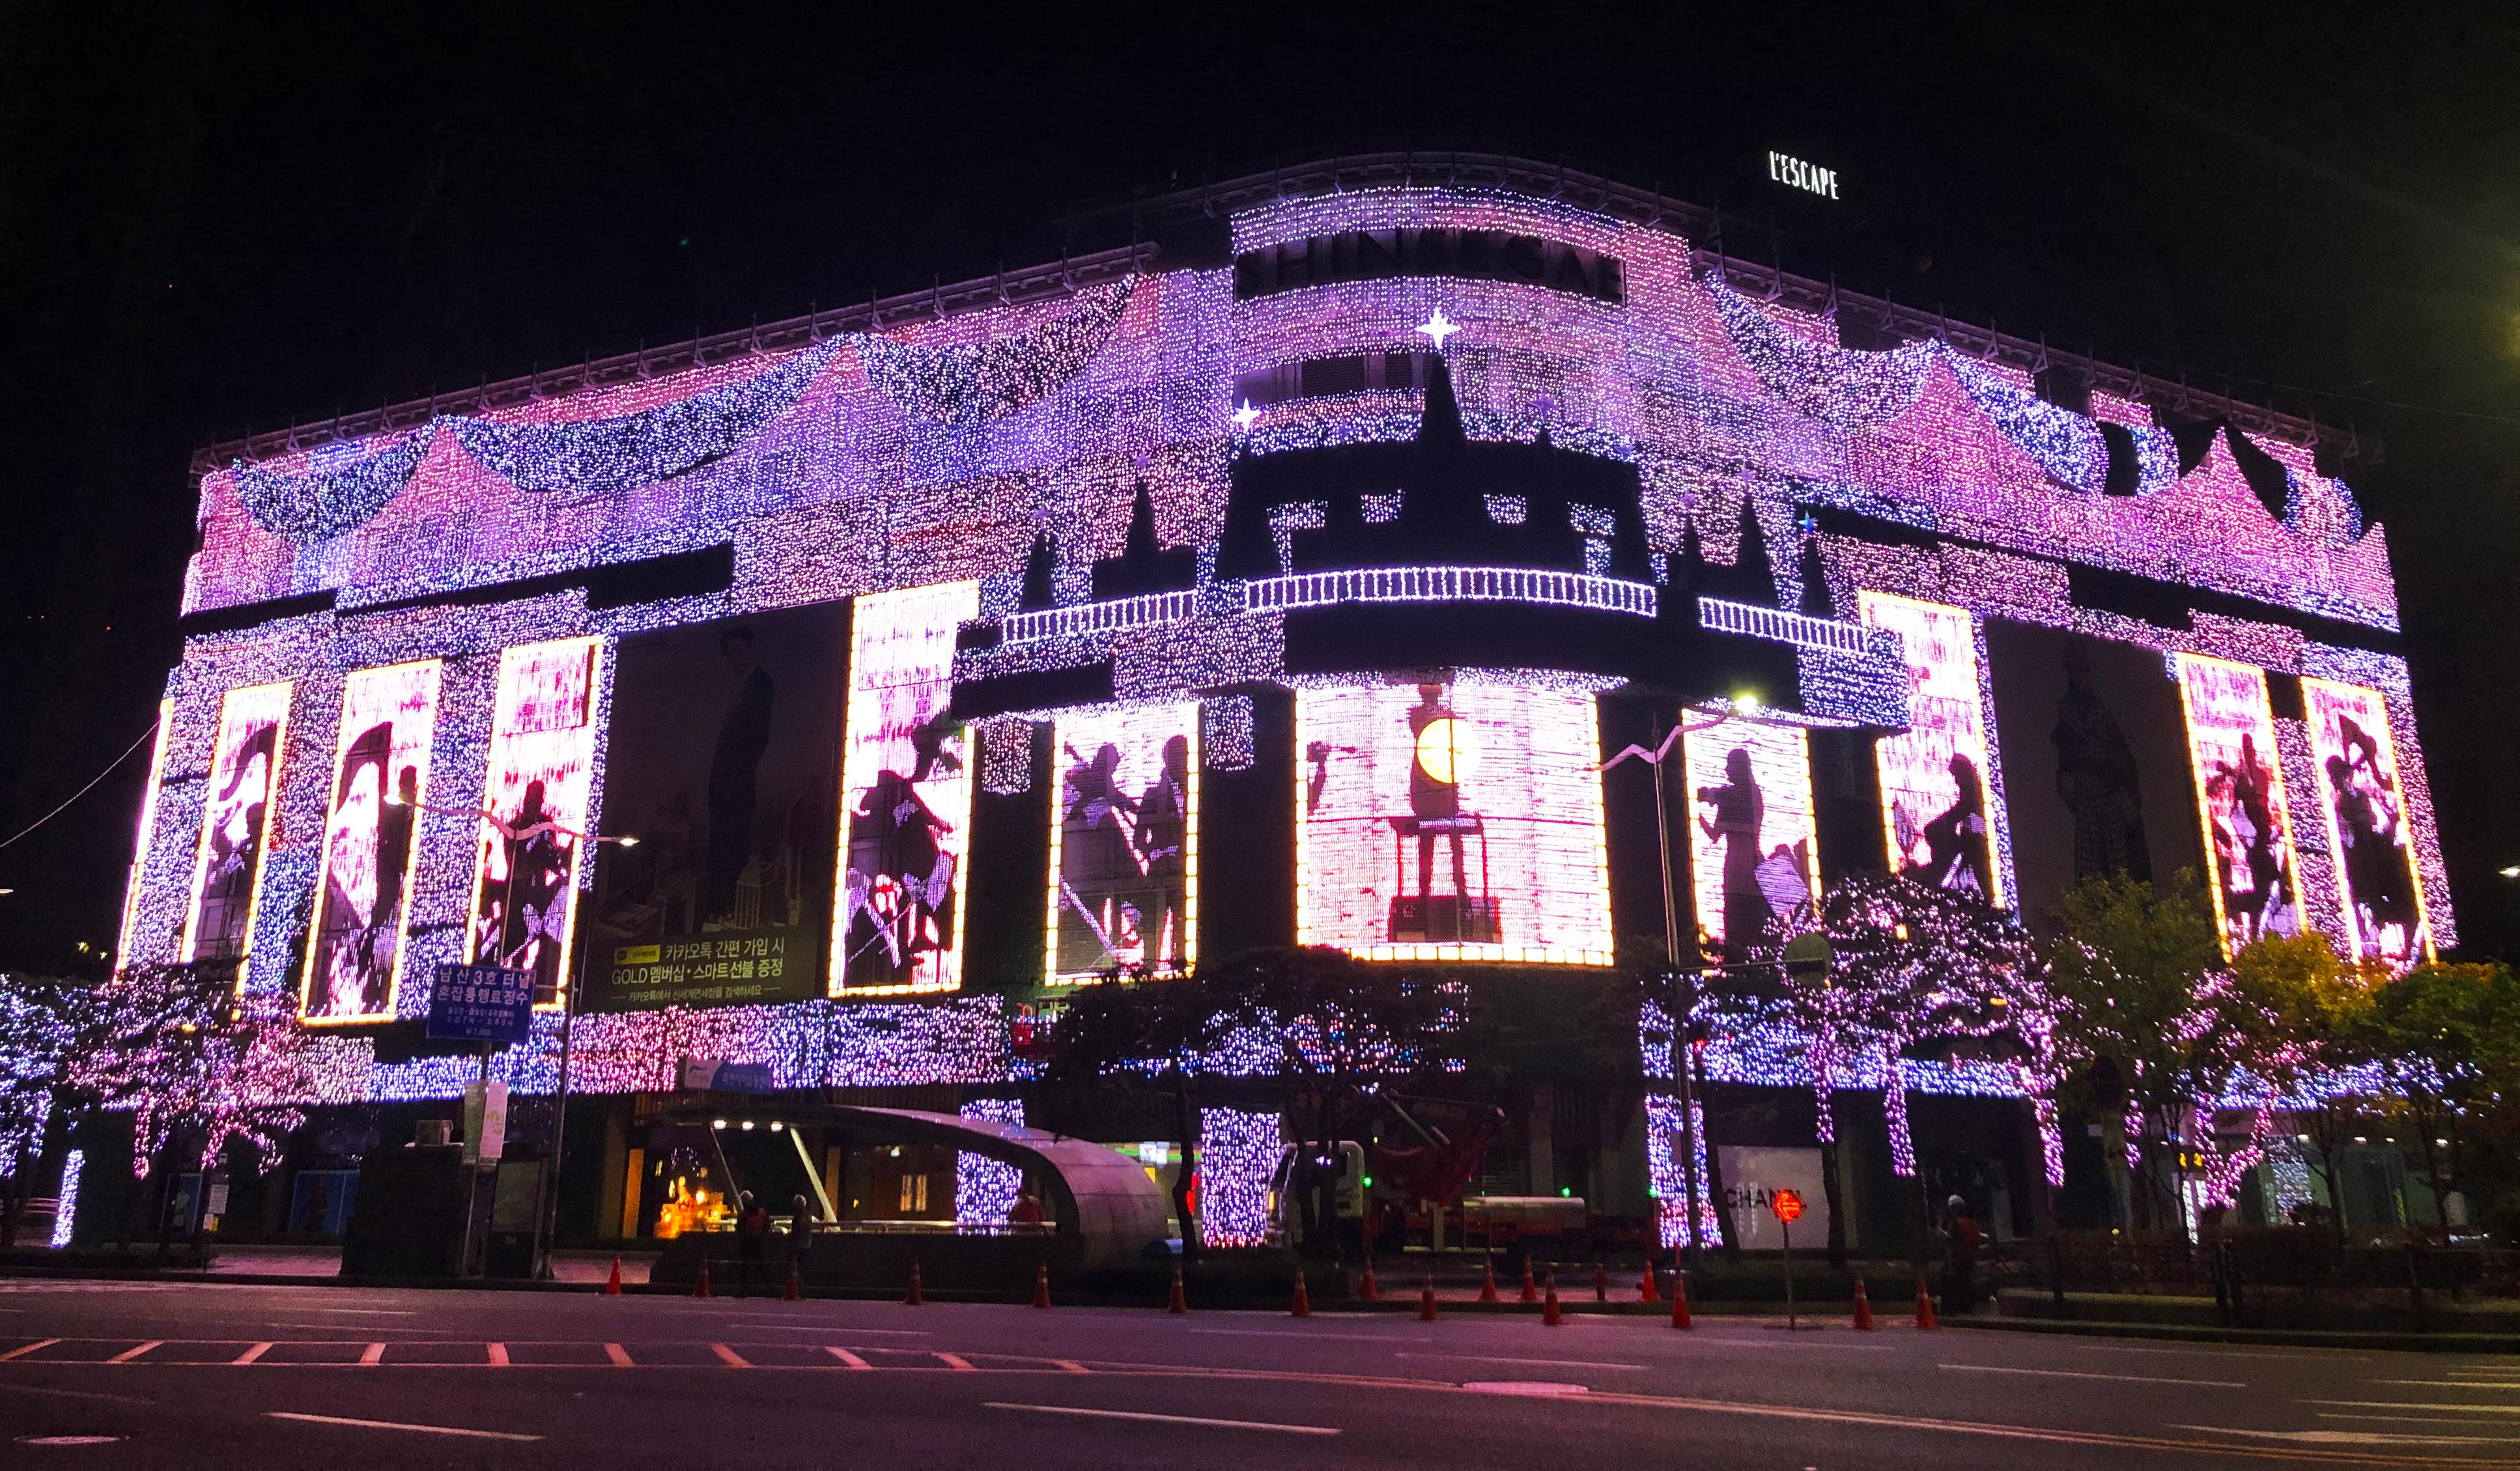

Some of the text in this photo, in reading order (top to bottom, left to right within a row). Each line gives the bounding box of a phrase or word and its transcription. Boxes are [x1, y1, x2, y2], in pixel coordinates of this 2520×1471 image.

[1769, 150, 1839, 200] L'ESCAPE
[1236, 227, 1622, 301] SHINSEGAE
[665, 942, 713, 962] 카카오톡
[716, 940, 740, 959] 간편
[744, 937, 768, 957] 가입
[772, 936, 784, 955] 시
[612, 968, 648, 985] GOLD
[757, 957, 784, 978] 증정
[629, 988, 670, 1002] 카카오톡에서
[725, 985, 762, 999] 검색하세요
